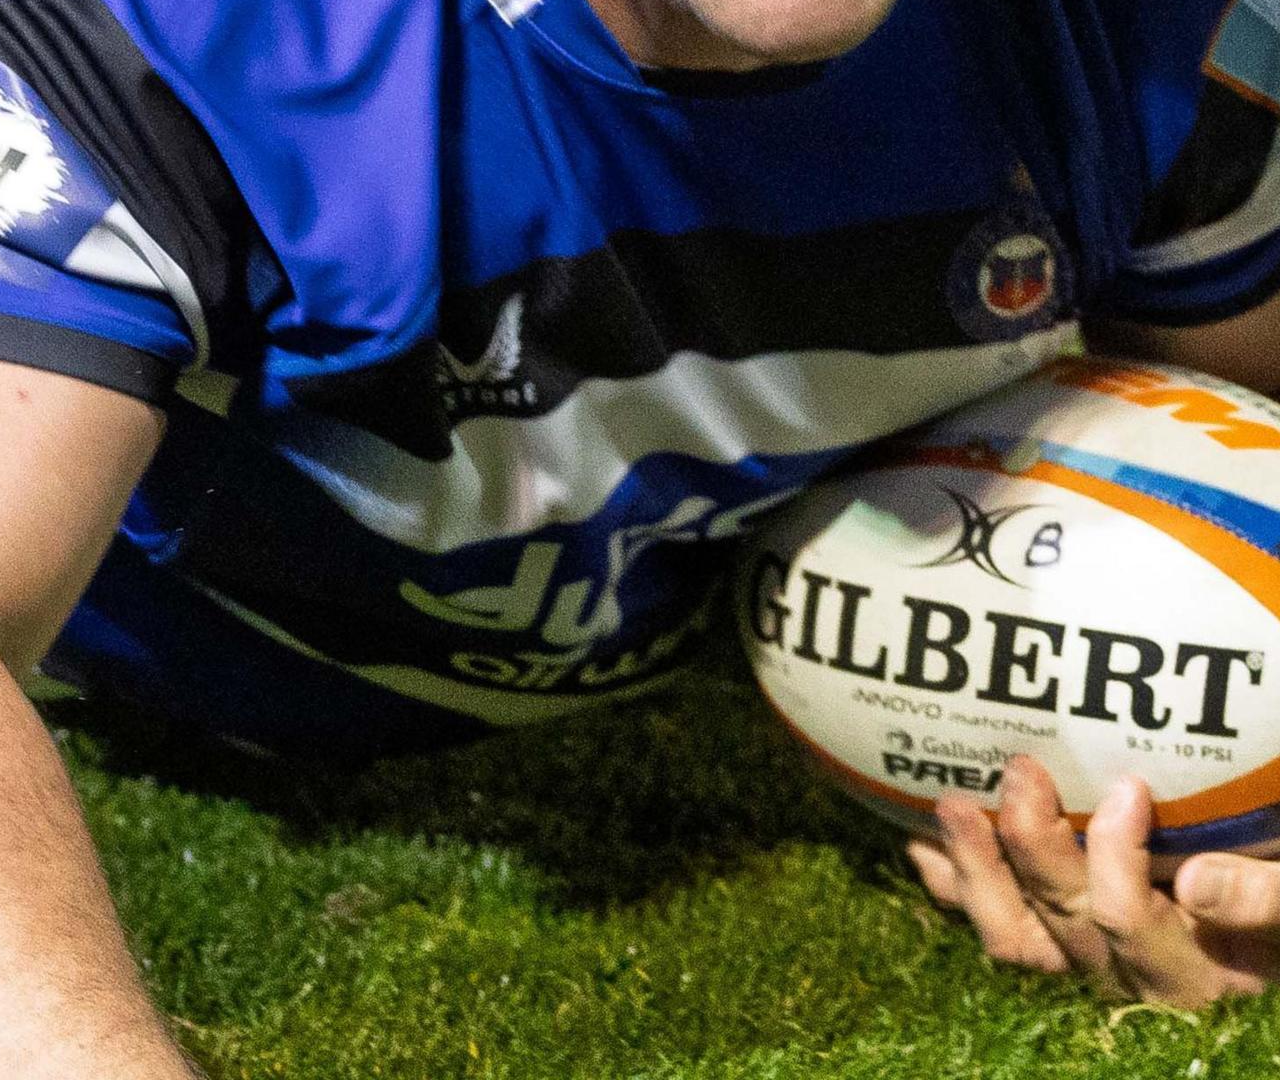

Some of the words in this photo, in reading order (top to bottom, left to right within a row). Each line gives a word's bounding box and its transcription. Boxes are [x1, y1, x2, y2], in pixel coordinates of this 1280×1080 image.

[747, 550, 1264, 738] GILBERT
[922, 734, 1010, 765] Gallagh
[1174, 743, 1194, 758] 10
[1201, 745, 1233, 762] PSI
